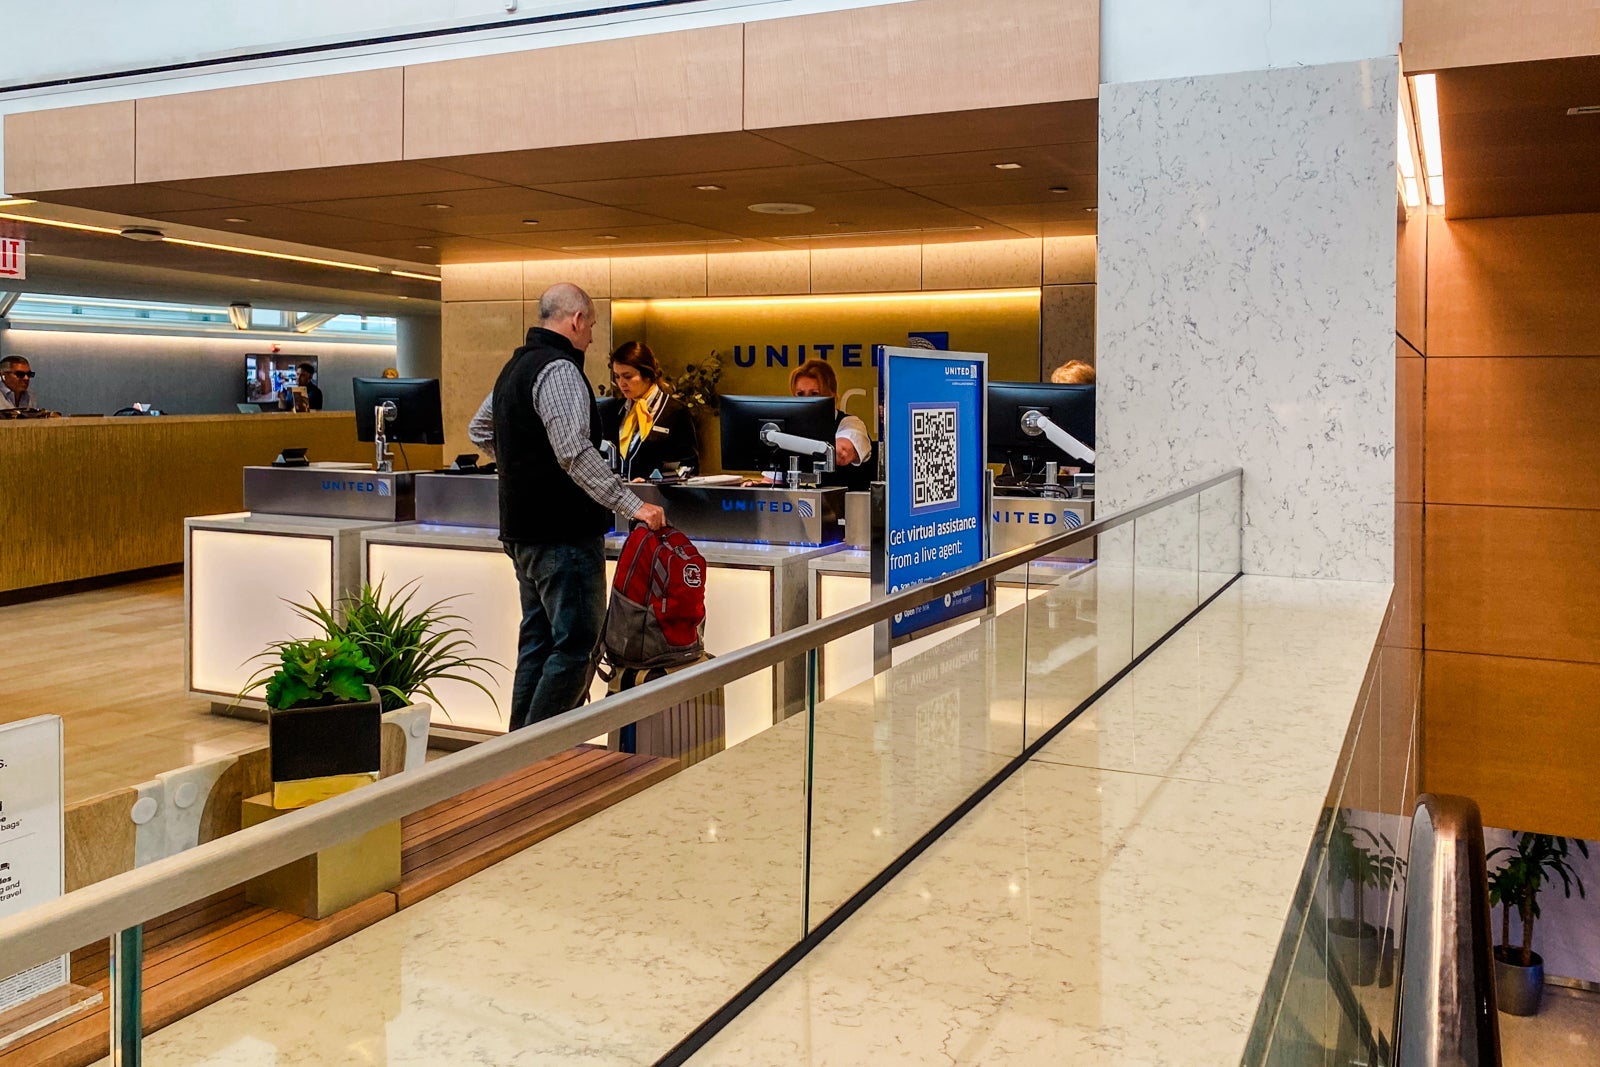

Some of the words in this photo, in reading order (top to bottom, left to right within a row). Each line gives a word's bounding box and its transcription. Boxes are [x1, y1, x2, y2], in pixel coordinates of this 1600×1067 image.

[2, 240, 19, 268] IT
[734, 344, 878, 368] UNITE
[944, 366, 970, 376] UNITED
[321, 480, 375, 492] UNITED
[722, 499, 793, 513] UNITED
[993, 511, 1057, 525] NITED
[890, 528, 906, 545] Get
[907, 521, 936, 542] virtual
[937, 516, 977, 536] assistance
[890, 554, 912, 570] from
[914, 551, 919, 565] a
[921, 546, 937, 563] live
[5, 880, 20, 892] and
